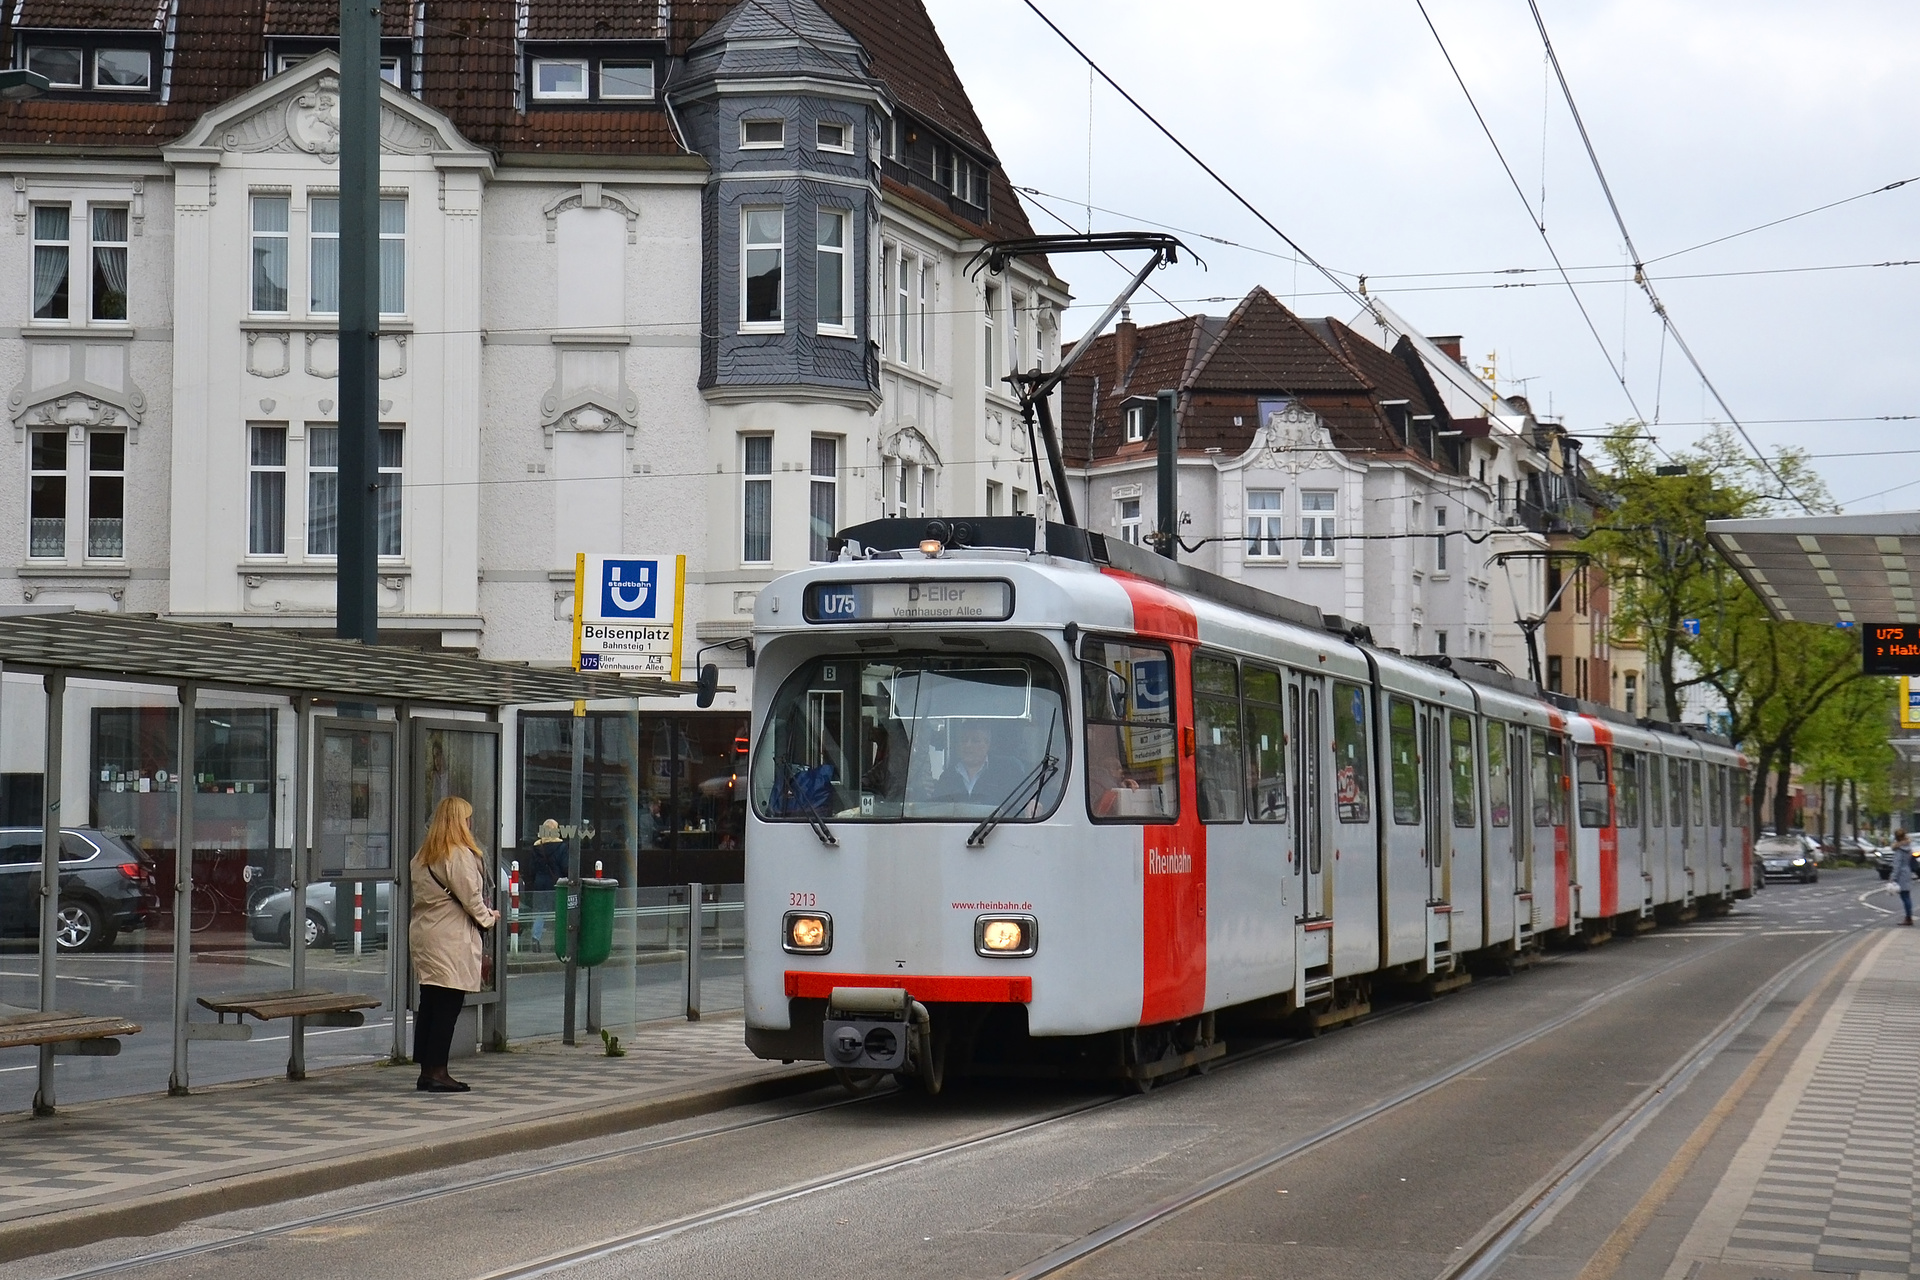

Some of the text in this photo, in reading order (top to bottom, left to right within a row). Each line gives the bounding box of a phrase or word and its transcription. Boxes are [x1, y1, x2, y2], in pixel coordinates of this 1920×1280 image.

[908, 586, 966, 601] D-Eller
[824, 594, 855, 614] U75
[892, 606, 983, 616] Vennhauser Allee
[585, 626, 670, 642] Belsenplatz
[1876, 628, 1904, 640] U75
[602, 641, 652, 651] Bahnsteig 1
[1889, 644, 1920, 656] Halt
[581, 657, 598, 667] U75
[599, 654, 615, 663] Eller
[599, 662, 665, 671] Vennhauser Allee
[826, 668, 834, 679] B
[863, 797, 872, 807] 04
[1149, 846, 1192, 875] Rheinbahn
[789, 892, 816, 907] 3213
[951, 900, 1033, 911] www.rheinbahn.de
